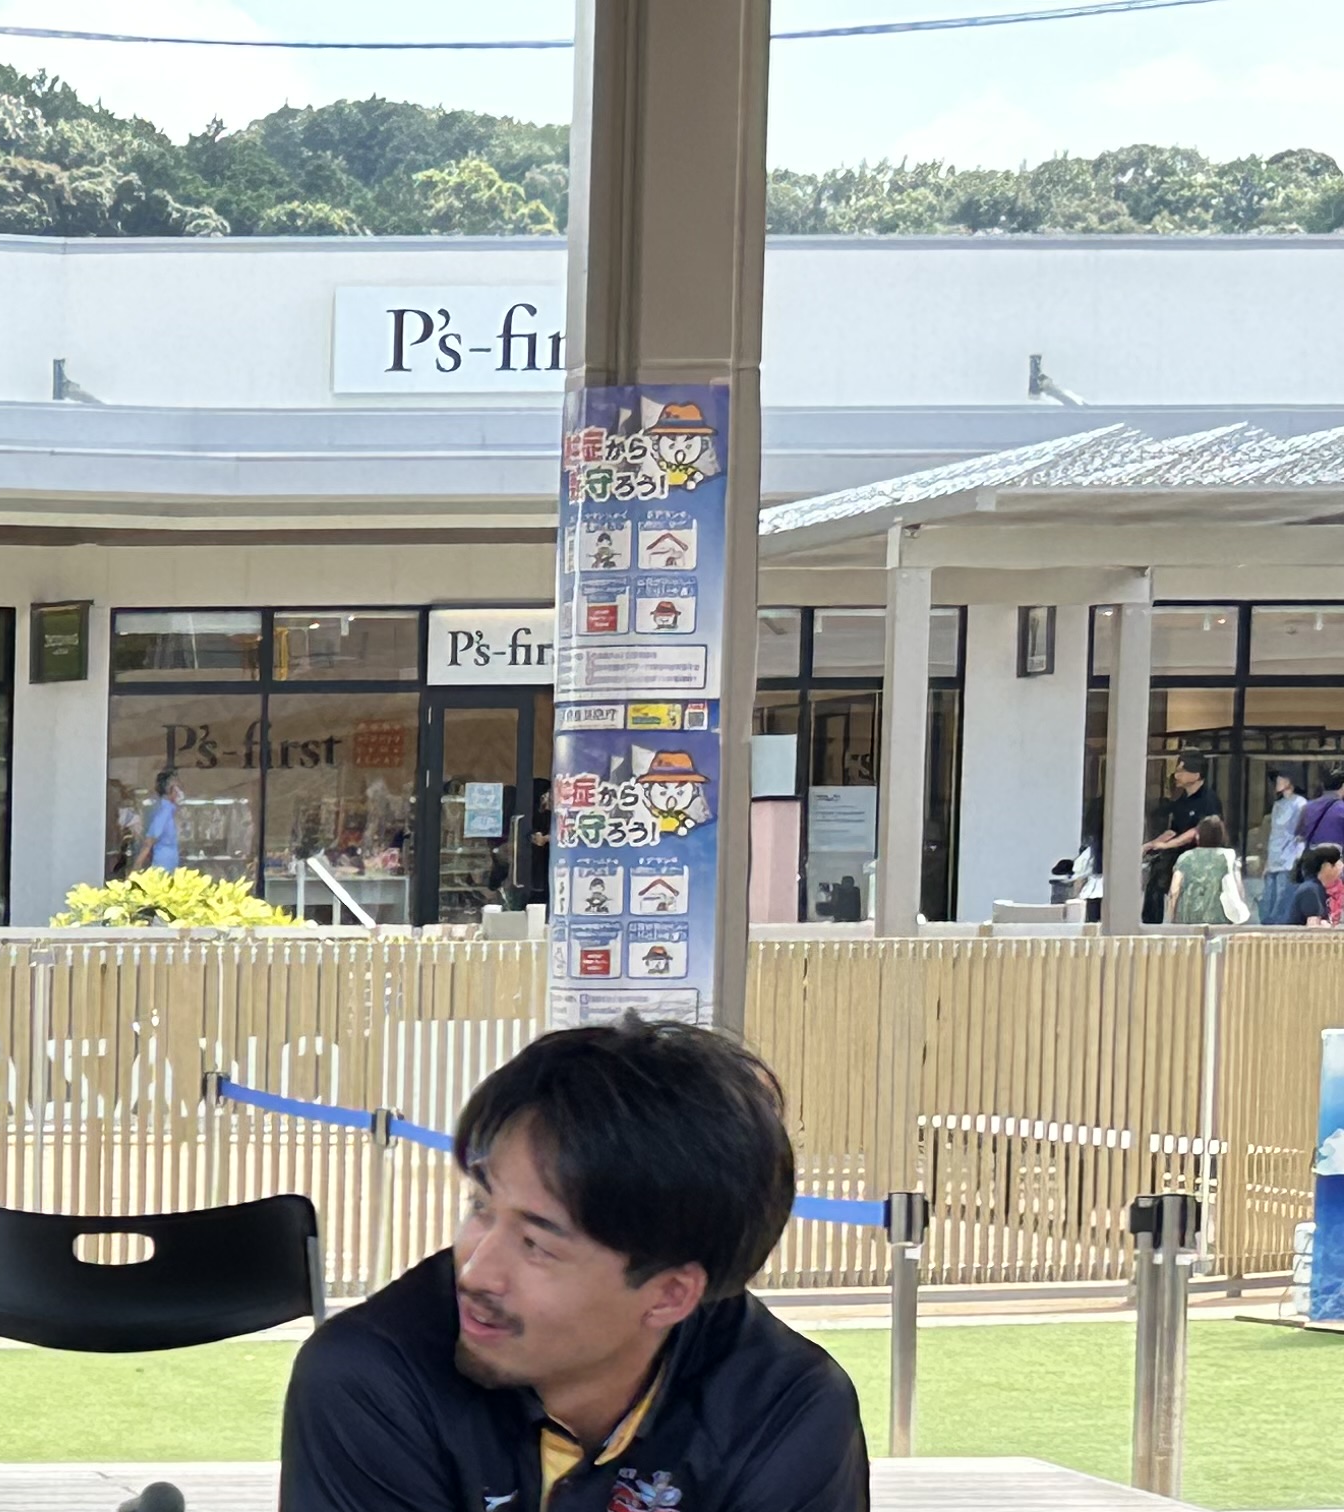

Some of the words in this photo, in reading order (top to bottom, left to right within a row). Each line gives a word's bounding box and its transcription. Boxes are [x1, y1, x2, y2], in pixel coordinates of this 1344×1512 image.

[384, 303, 566, 373] P's-fir
[447, 627, 553, 667] P's-fir
[161, 720, 343, 769] P's-first
